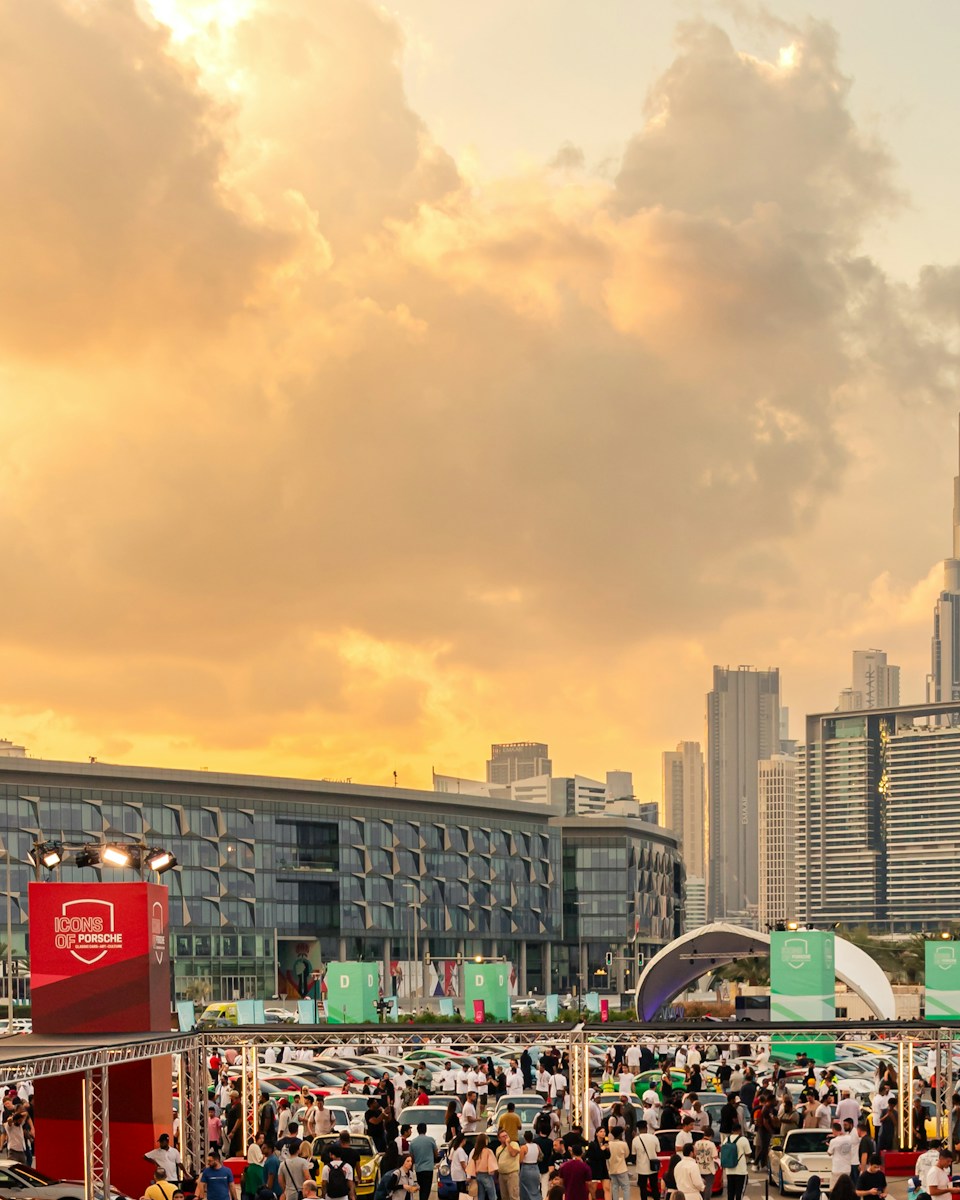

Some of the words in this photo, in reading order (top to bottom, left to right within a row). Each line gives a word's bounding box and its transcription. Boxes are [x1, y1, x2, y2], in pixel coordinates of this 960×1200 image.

[54, 916, 103, 933] ICONS
[55, 933, 76, 949] OF
[78, 933, 123, 943] PORSCHE
[340, 974, 350, 988] D
[367, 974, 374, 987] D
[475, 974, 484, 986] D
[499, 974, 504, 986] D
